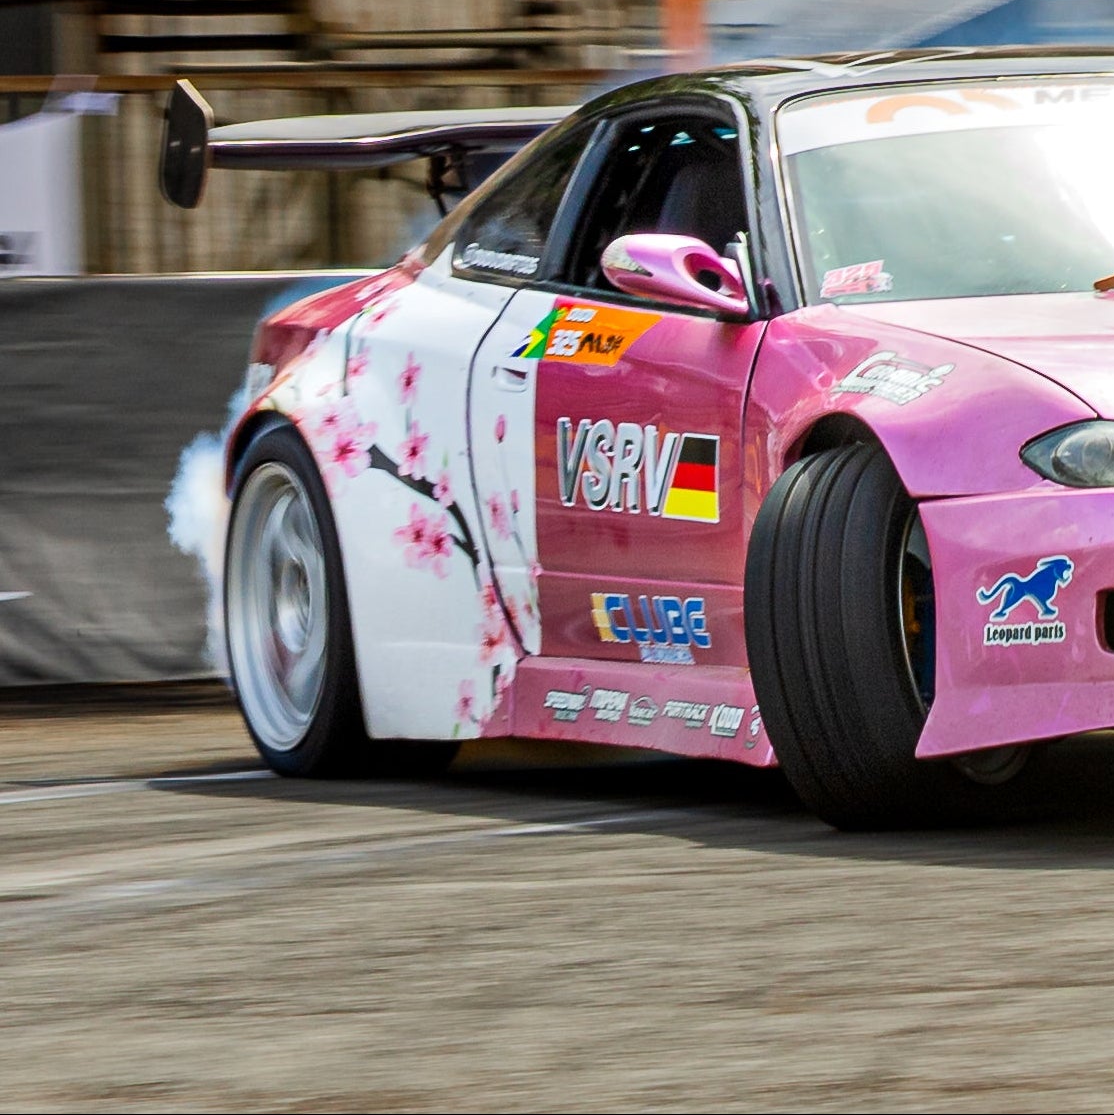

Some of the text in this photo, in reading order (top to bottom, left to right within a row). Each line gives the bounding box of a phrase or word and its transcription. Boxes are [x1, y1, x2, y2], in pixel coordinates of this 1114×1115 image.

[556, 416, 680, 517] VSRV
[985, 623, 1064, 644] Leopard parts
